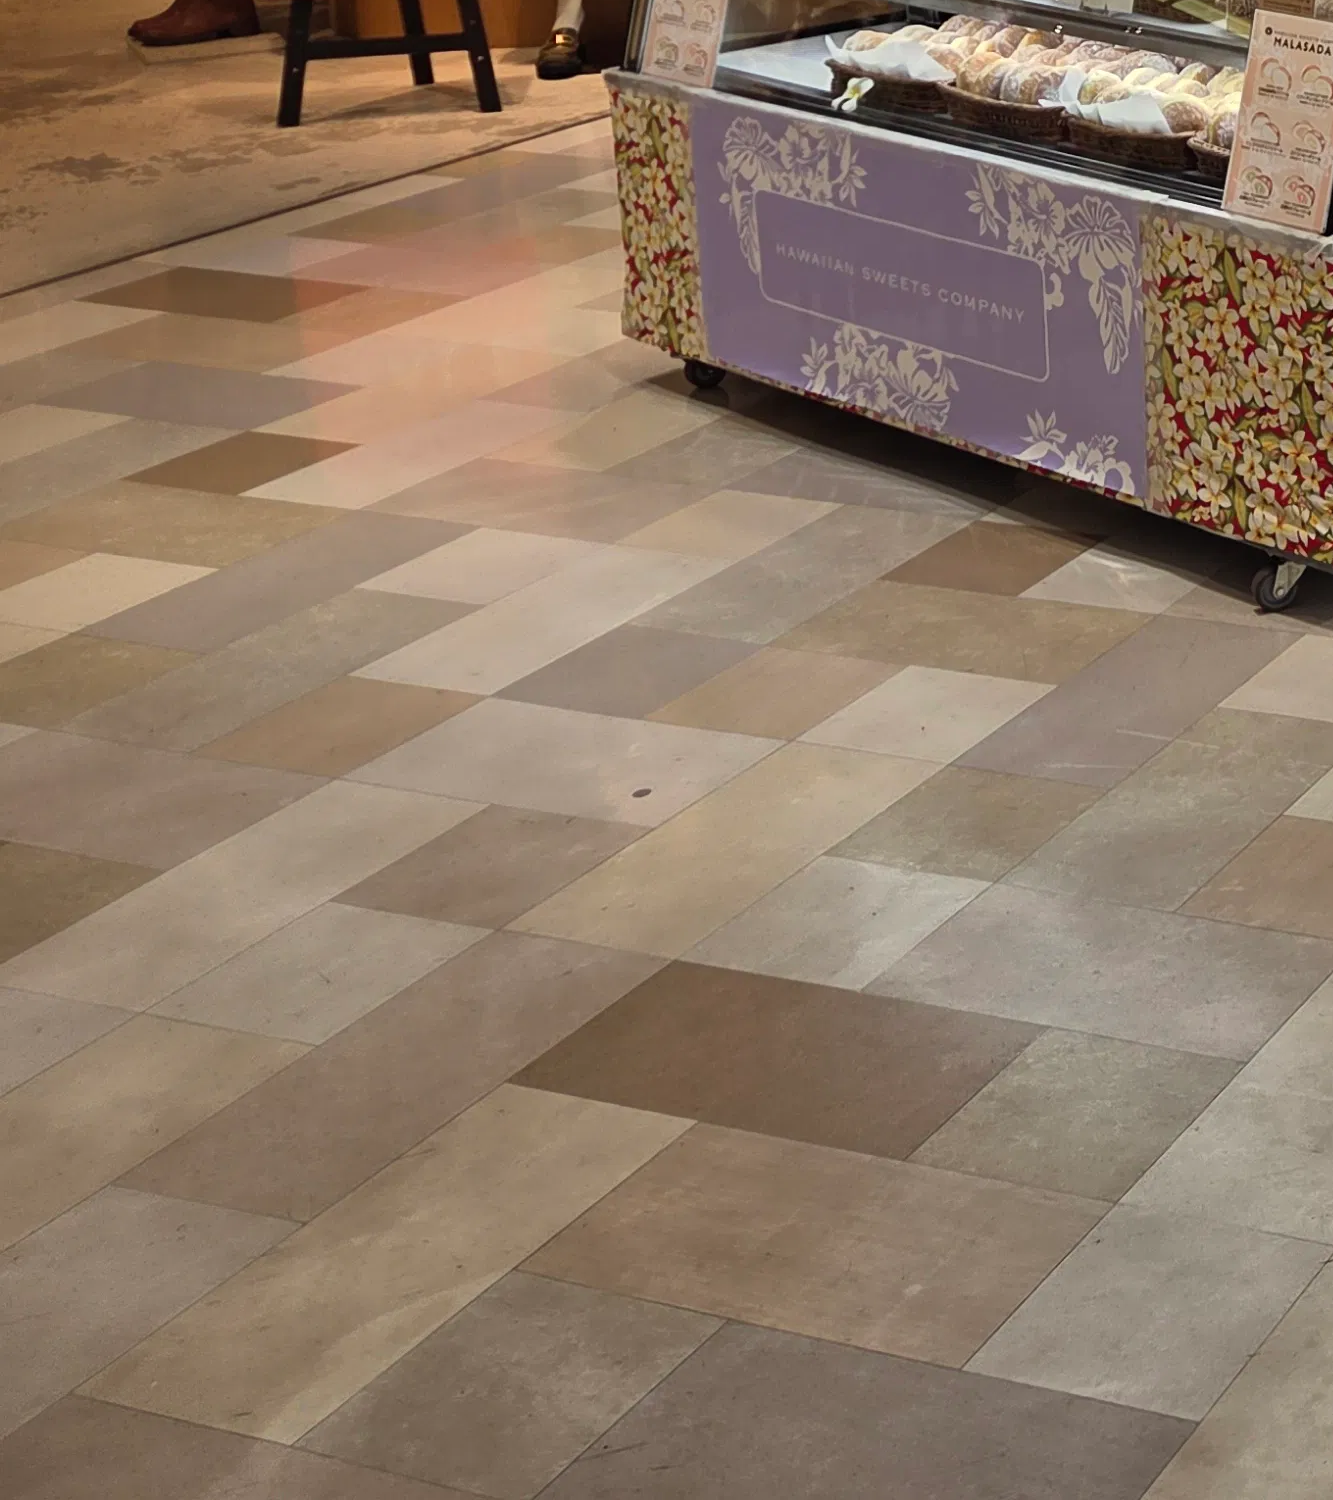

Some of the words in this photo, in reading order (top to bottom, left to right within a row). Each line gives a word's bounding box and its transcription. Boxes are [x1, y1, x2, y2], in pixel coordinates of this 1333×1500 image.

[1273, 36, 1332, 56] MALASADA
[776, 243, 854, 276] HAWAIIAN
[862, 266, 931, 297] SWEETS
[938, 288, 1025, 323] COMPANY
